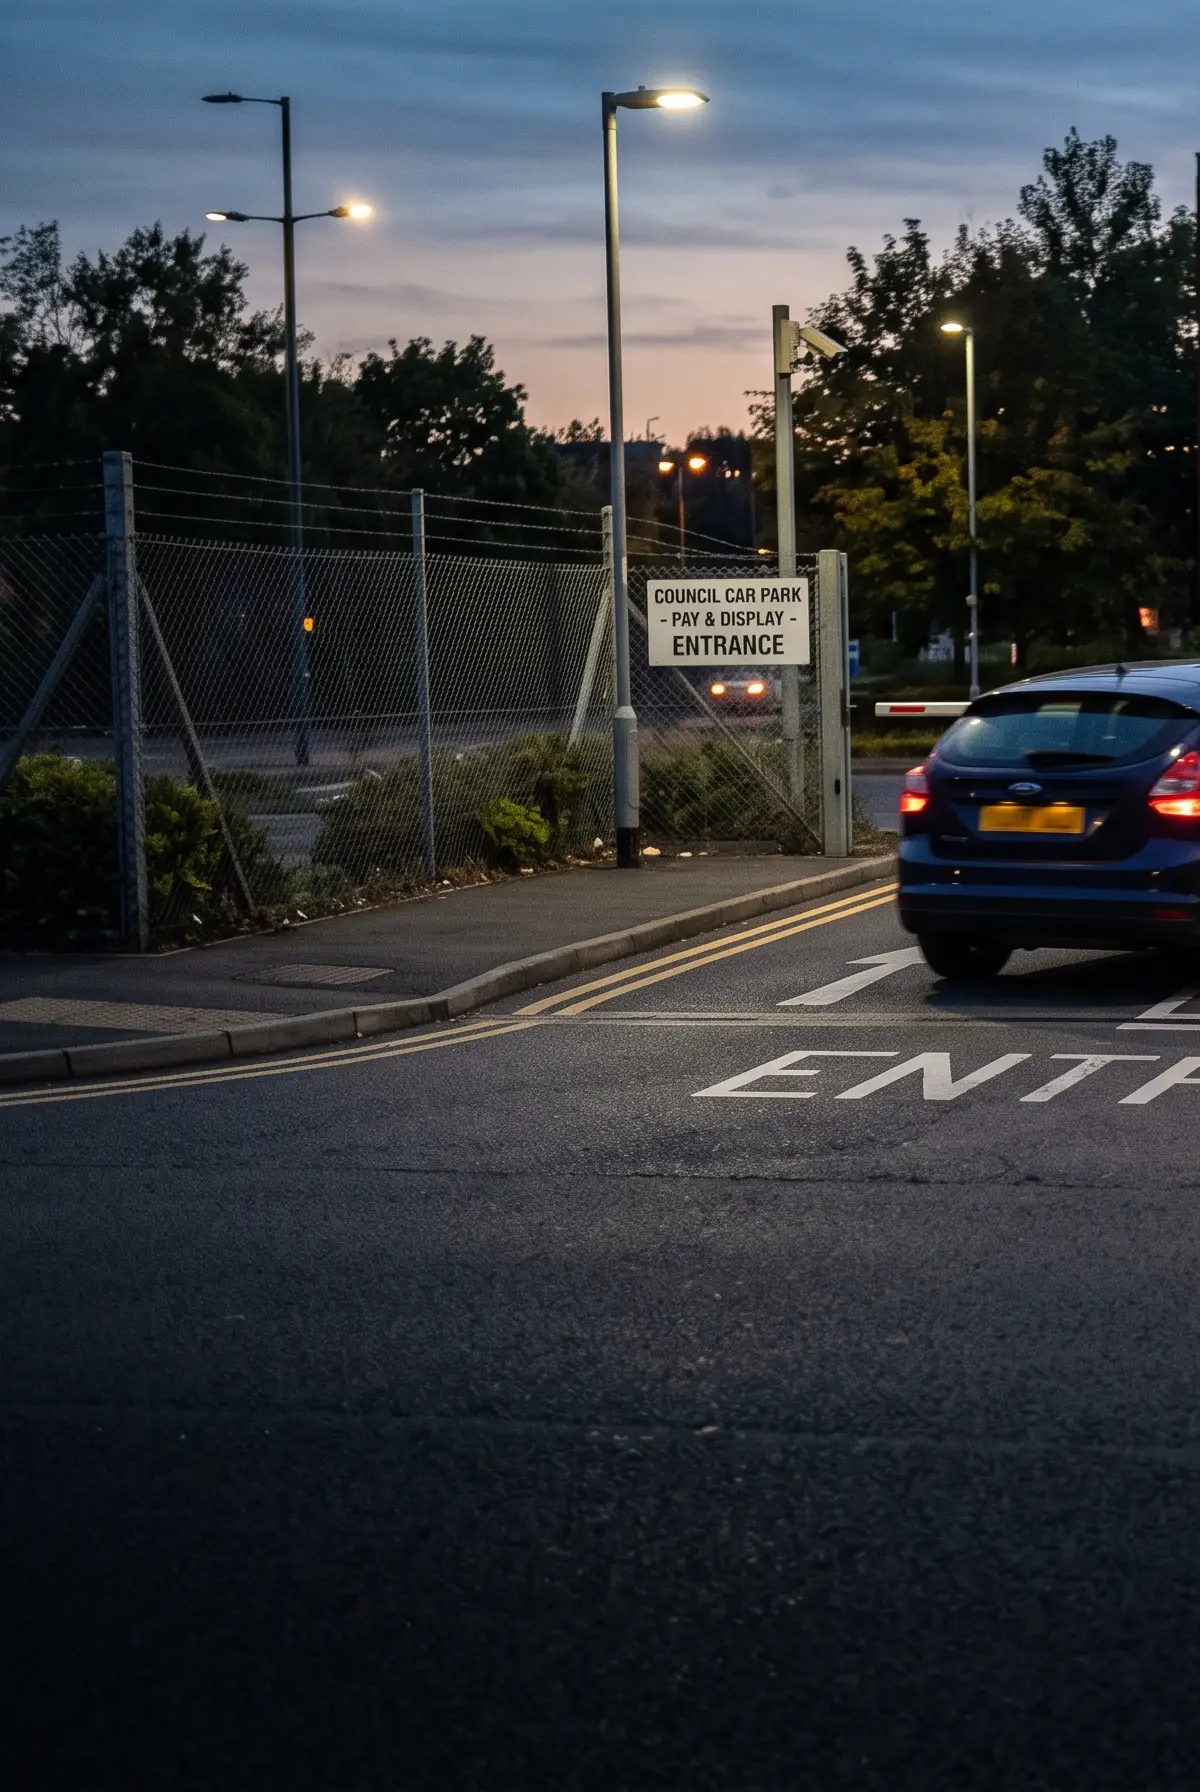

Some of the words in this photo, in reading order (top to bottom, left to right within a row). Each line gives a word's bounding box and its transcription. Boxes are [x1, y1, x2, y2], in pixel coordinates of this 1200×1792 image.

[654, 588, 721, 604] COUNCIL
[725, 587, 756, 604] CAR
[760, 587, 802, 603] PARK
[672, 611, 701, 627] PAY
[704, 611, 716, 627] &
[720, 611, 785, 627] DISPLAY
[673, 634, 785, 656] ENTRANCE
